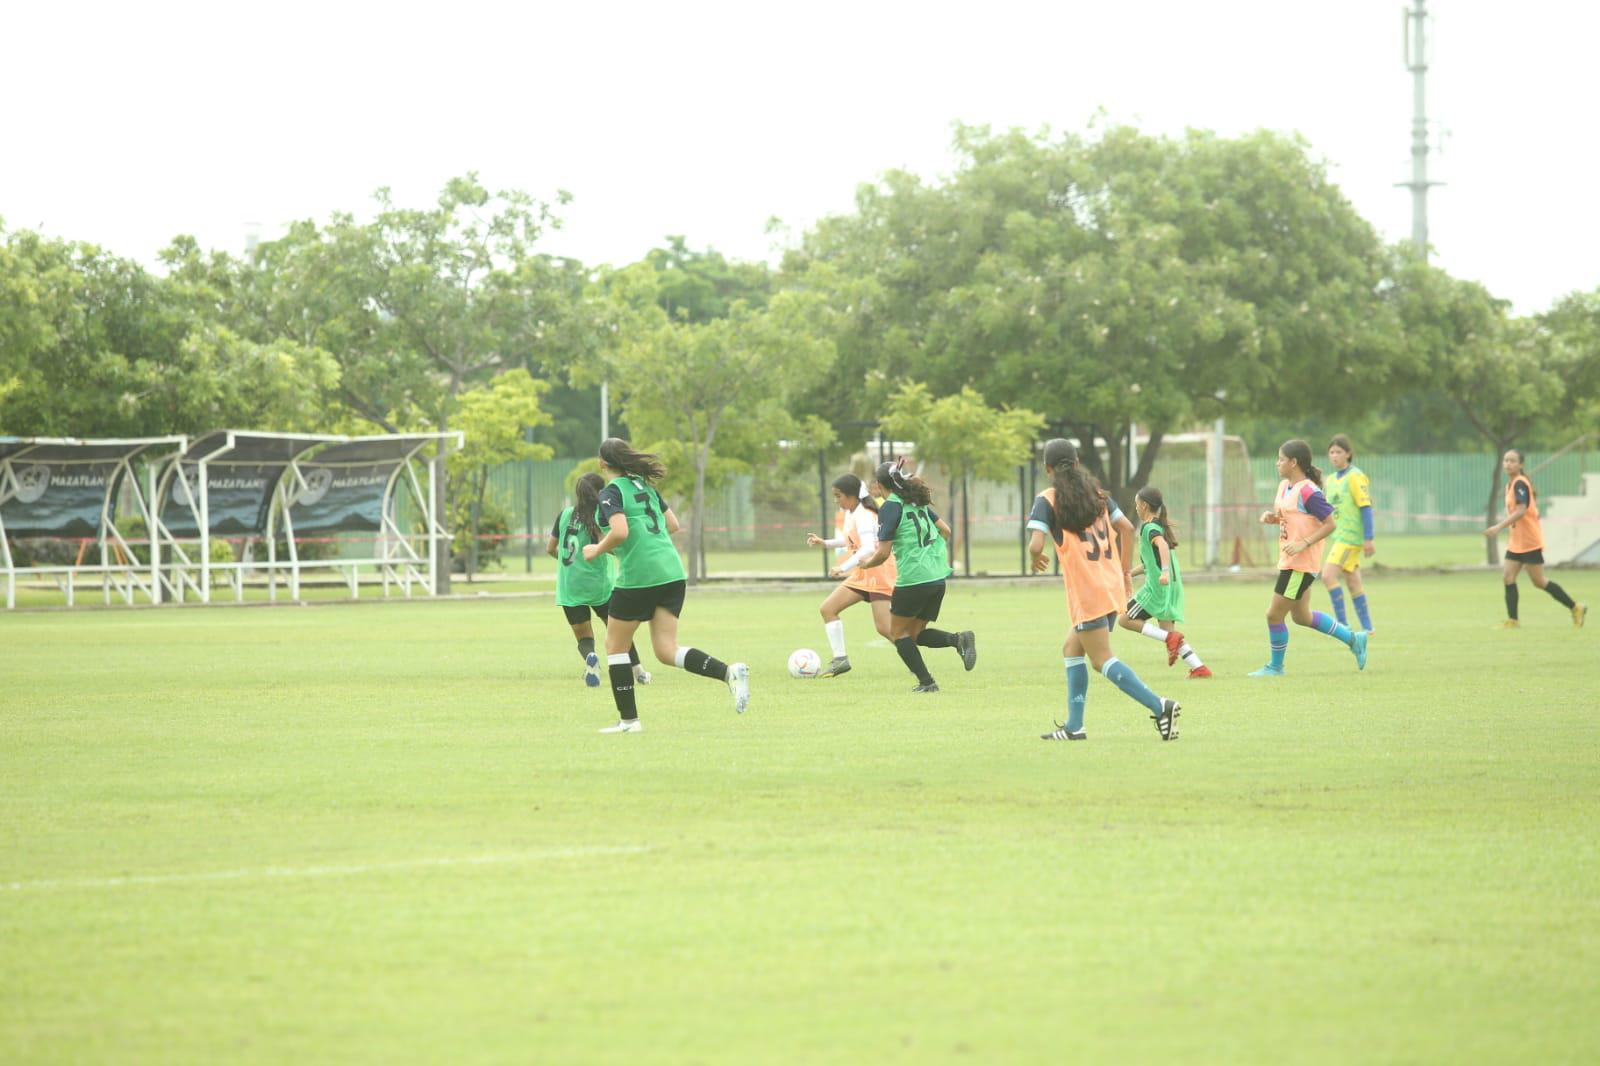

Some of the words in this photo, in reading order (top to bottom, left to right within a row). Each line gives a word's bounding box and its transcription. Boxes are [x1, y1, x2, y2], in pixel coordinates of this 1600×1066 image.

[633, 491, 660, 535] 3
[906, 510, 936, 548] 12
[562, 527, 579, 567] 5
